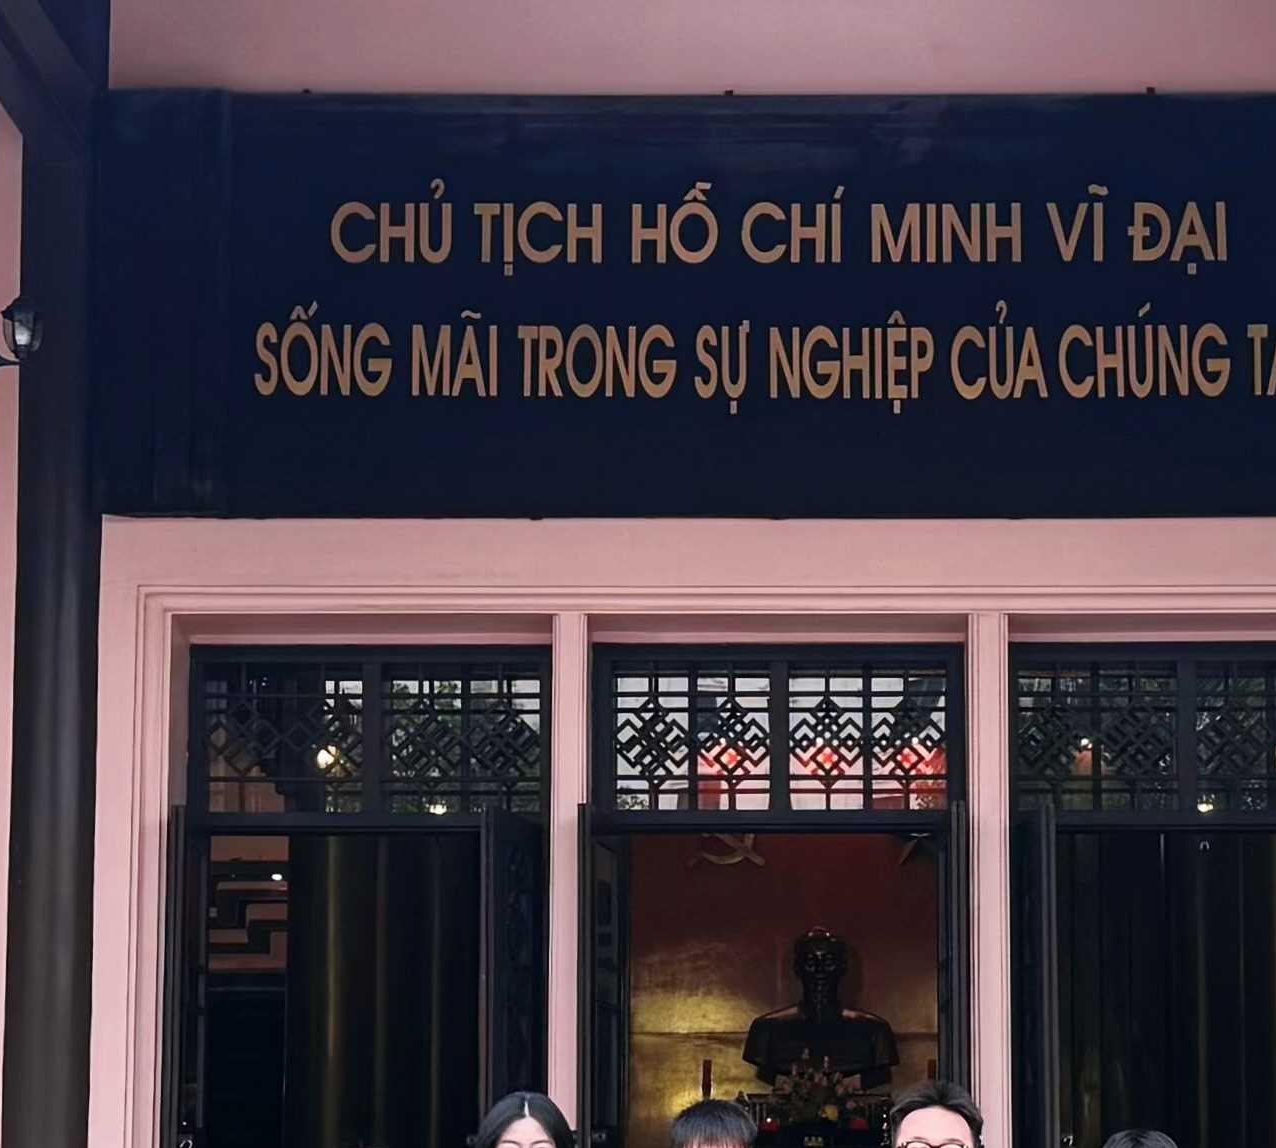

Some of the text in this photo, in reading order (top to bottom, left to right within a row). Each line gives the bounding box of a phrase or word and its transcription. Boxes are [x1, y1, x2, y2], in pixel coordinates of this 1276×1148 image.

[331, 178, 452, 264] CHỦ
[474, 202, 603, 276] TỊCH
[741, 185, 845, 264] CHÍ
[871, 202, 1022, 263] MINH
[1046, 184, 1109, 262] VĨ
[1127, 201, 1227, 275] ĐẠI
[254, 300, 392, 397] SỐNG
[411, 310, 498, 397] MÃI
[517, 324, 677, 398] TRONG
[694, 319, 750, 415] SỰ
[769, 310, 934, 414] NGHIỆP
[950, 299, 1049, 400] CỦA
[1058, 302, 1231, 398] CHÚNG
